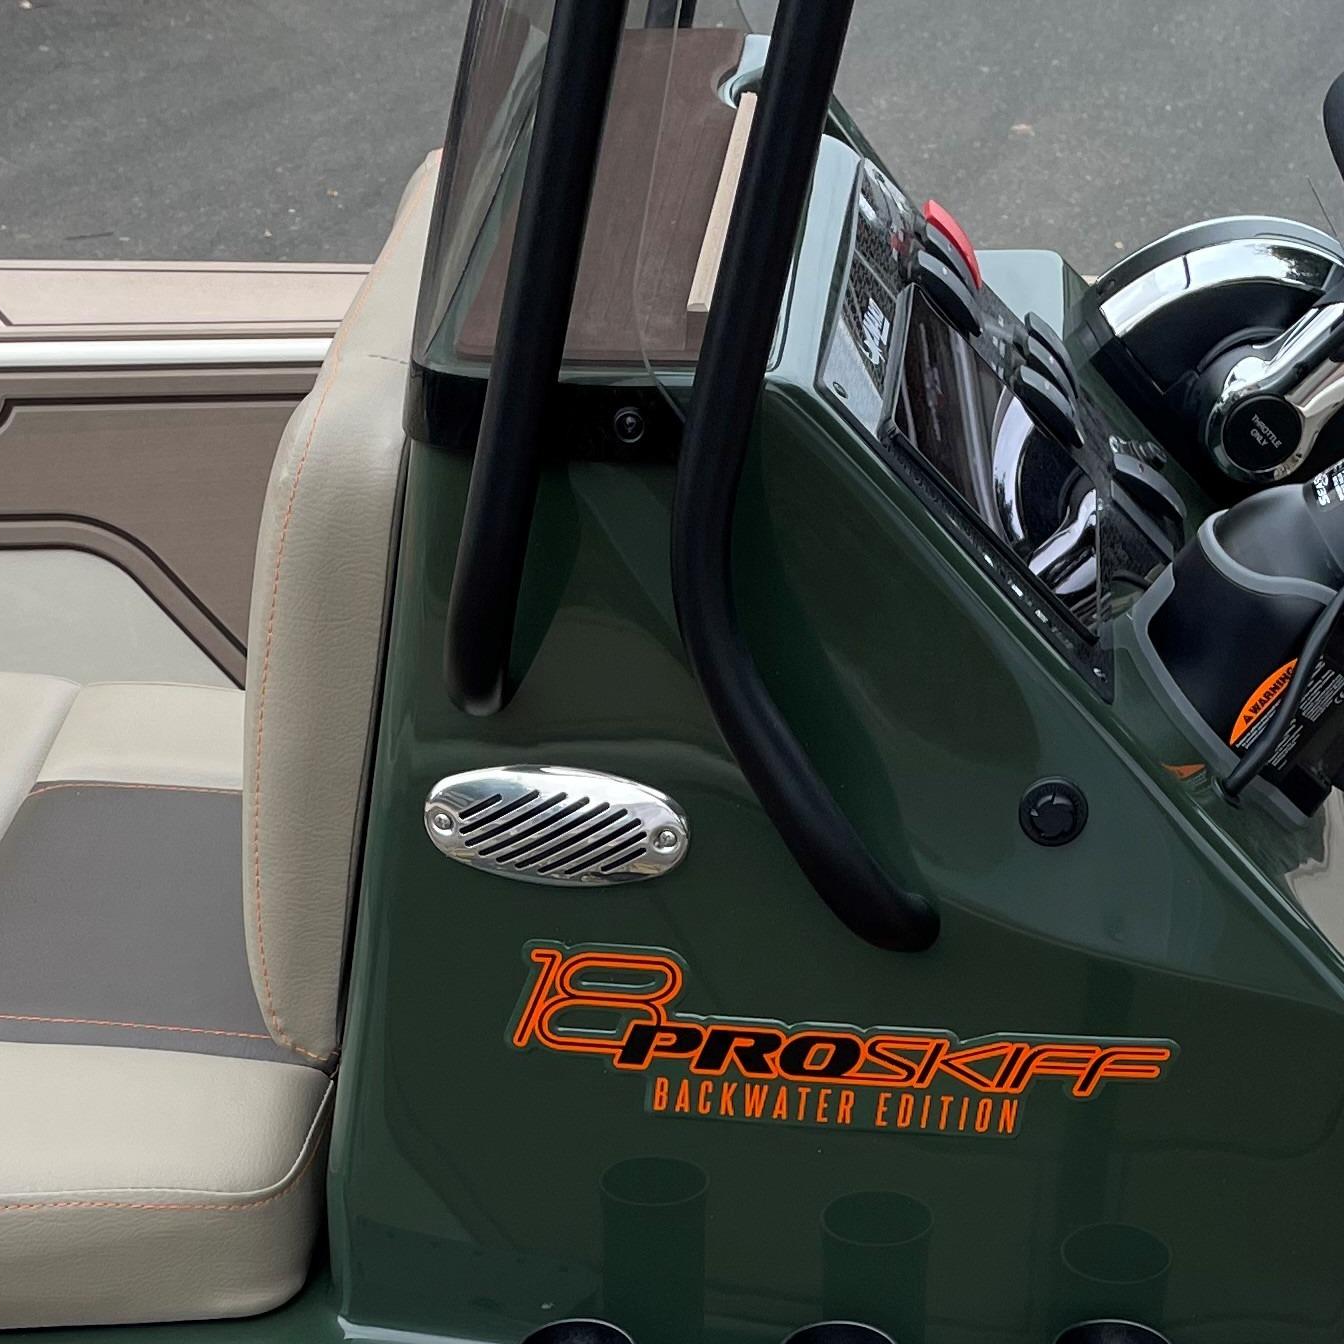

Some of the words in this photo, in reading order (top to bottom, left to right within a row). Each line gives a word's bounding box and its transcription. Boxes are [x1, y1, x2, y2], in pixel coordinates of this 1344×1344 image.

[1250, 428, 1269, 447] ONLY
[1252, 414, 1282, 448] THROTTLE
[512, 949, 683, 1052] 18
[653, 1077, 855, 1125] BACKWATER
[874, 1092, 1019, 1135] EDITION
